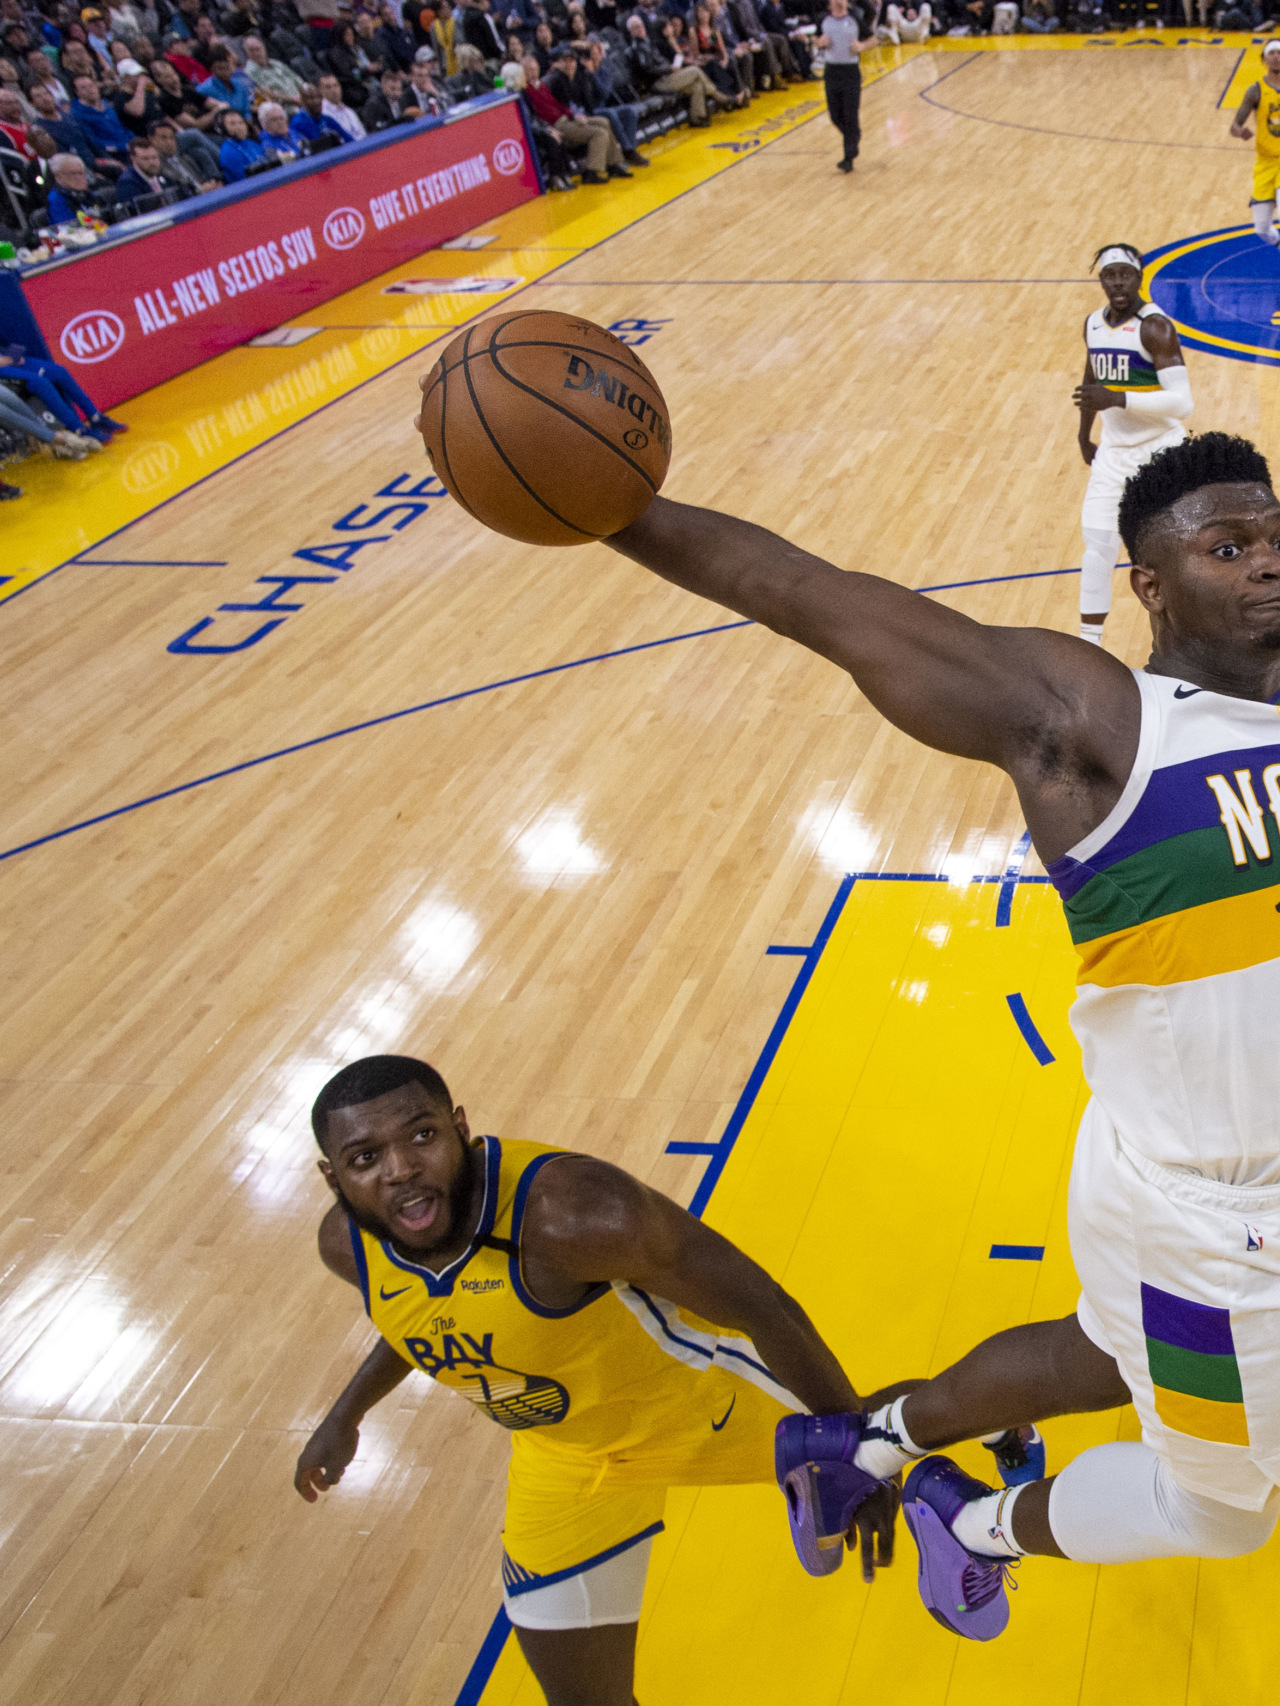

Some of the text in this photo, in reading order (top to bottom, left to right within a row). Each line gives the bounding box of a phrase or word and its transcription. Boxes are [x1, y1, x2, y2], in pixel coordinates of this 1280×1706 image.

[68, 318, 118, 357] KIA
[133, 267, 221, 335] ALL-NEW
[218, 240, 285, 297] SELTOS
[281, 226, 318, 270] SUV
[369, 189, 405, 230] GIVE
[402, 183, 419, 216] IT
[416, 153, 491, 209] EVERYTHING
[563, 354, 670, 450] ALDING
[166, 472, 448, 655] CHASE
[461, 1278, 504, 1292] Rakuten
[430, 1316, 456, 1335] The
[403, 1332, 496, 1379] BAY
[461, 1374, 492, 1402] 7
